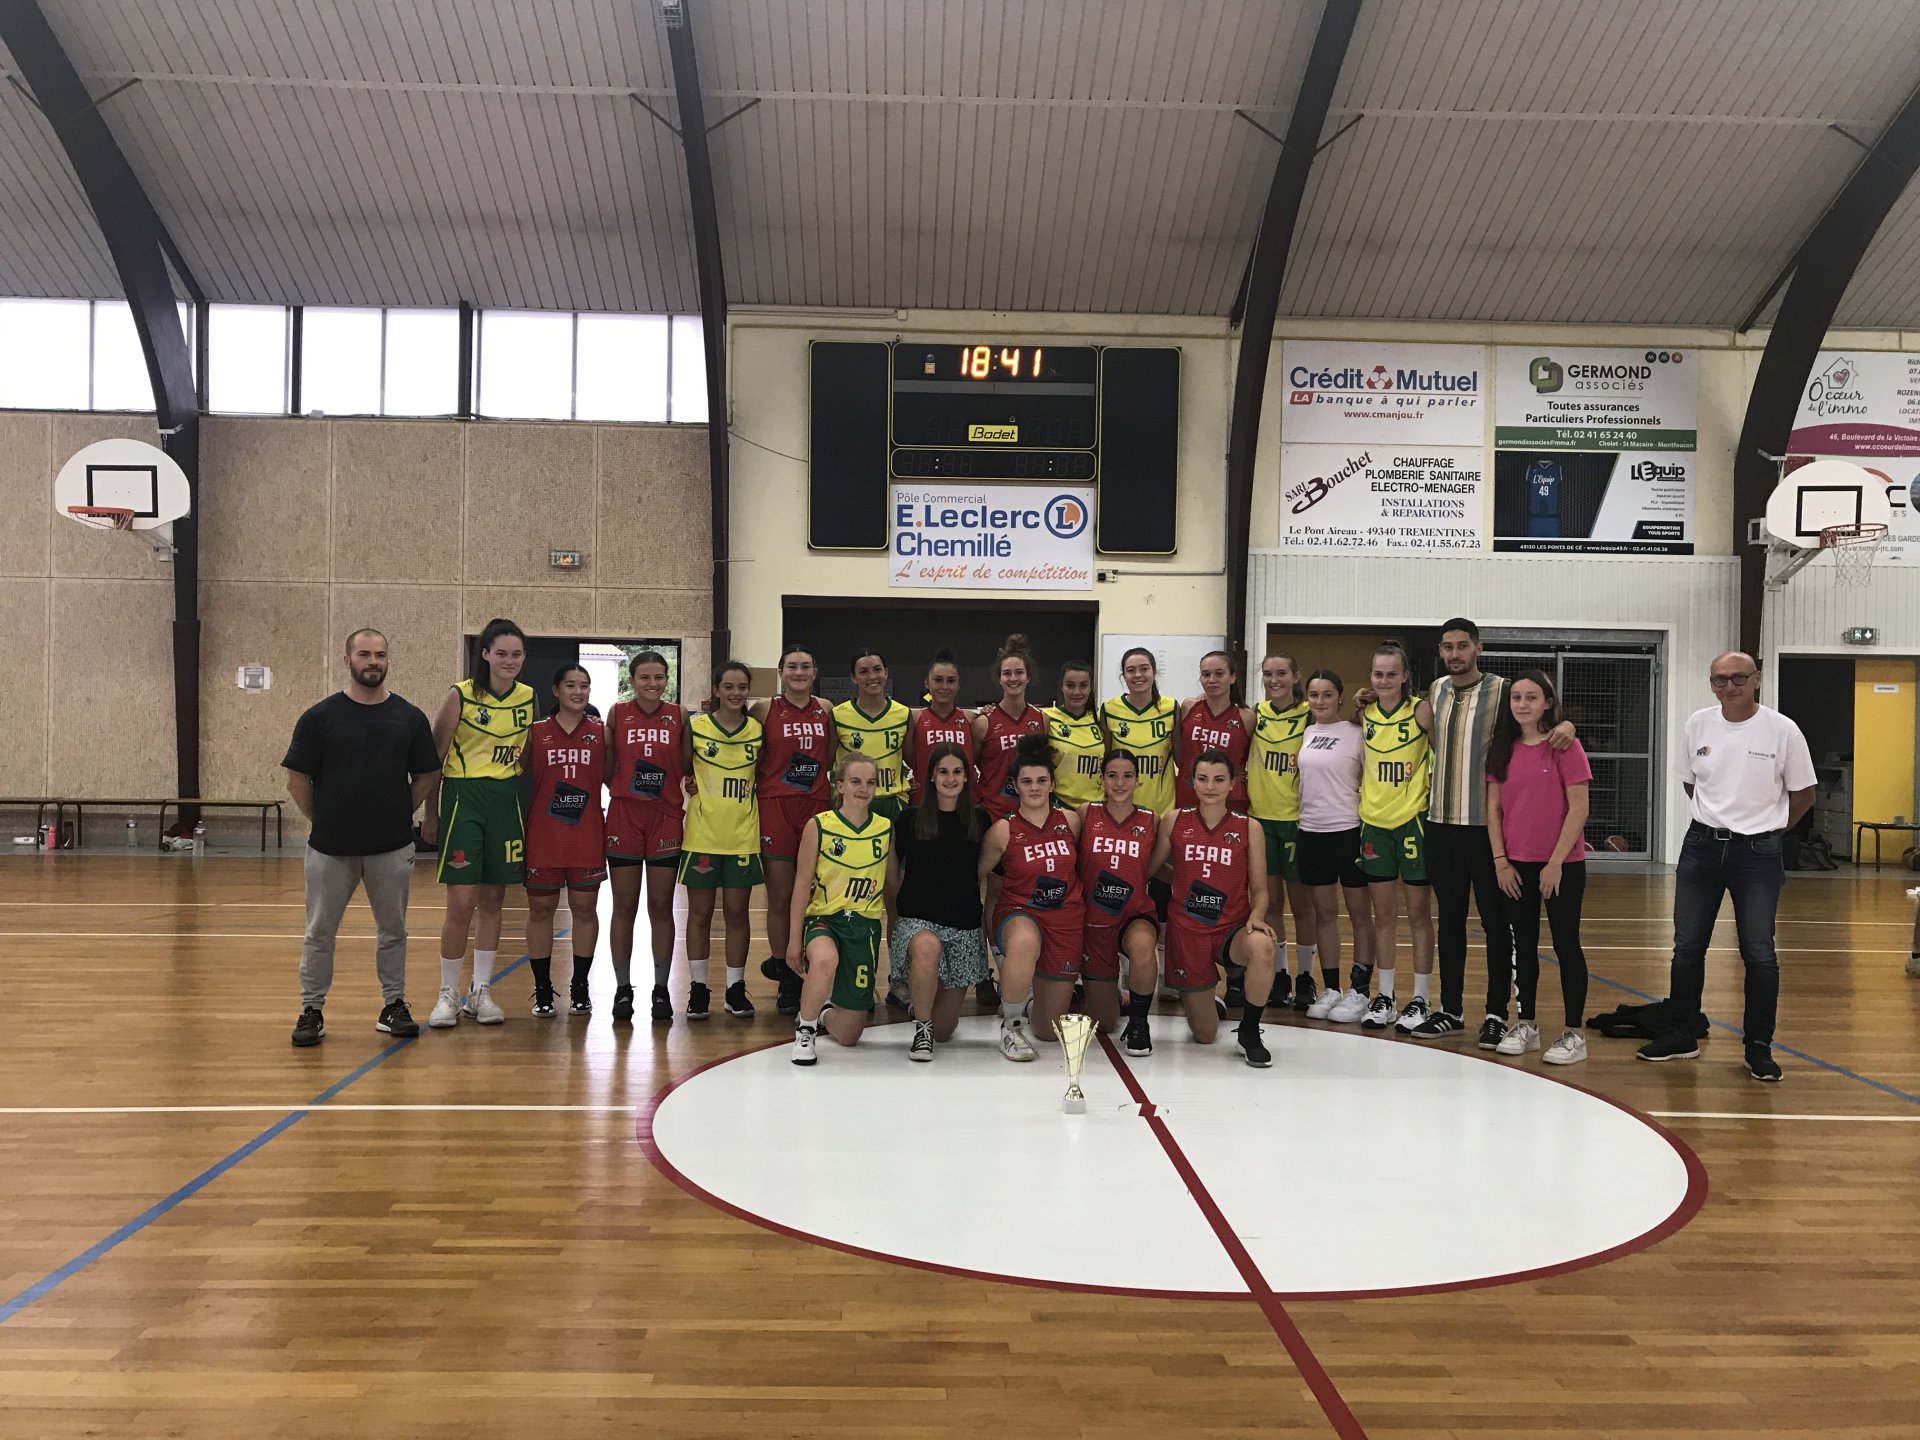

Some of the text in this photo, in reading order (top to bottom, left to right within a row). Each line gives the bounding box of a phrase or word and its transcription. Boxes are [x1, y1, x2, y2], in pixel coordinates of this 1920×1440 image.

[960, 347, 1042, 377] 18:41
[1290, 366, 1477, 391] Crédit Mutuel
[1568, 365, 1651, 379] GERMOND
[1576, 380, 1644, 390] associés
[1809, 376, 1824, 402] Ô
[1294, 394, 1476, 408] LA banque à qui parler
[1548, 401, 1640, 412] Toutes assurances
[1808, 403, 1816, 412] de
[1344, 410, 1424, 420] www.cmanjou.fr
[1526, 414, 1660, 425] Particuliers Professionnels
[971, 427, 1016, 440] Bodet
[1556, 430, 1572, 438] Tél.
[1613, 431, 1624, 439] 24
[1393, 457, 1454, 468] CHAUFFAGE
[1284, 450, 1374, 514] SARL Bouchet
[1365, 470, 1481, 481] PLOMBERIE SANITAIRE
[1371, 482, 1475, 494] ELECTRO-MENAGER
[1539, 486, 1549, 496] 49
[898, 493, 986, 503] Pôle Commercial
[1381, 498, 1465, 508] INSTALLATIONS
[897, 504, 1040, 528] E.Leclerc
[1392, 510, 1464, 518] REPARATIONS
[1289, 526, 1301, 534] Le
[1304, 526, 1324, 535] Pont
[1327, 527, 1357, 535] Aireau
[1367, 527, 1396, 536] 49340
[1399, 528, 1475, 537] TREMENTINES
[896, 532, 1011, 557] Chemillé
[1283, 537, 1480, 548] Tél.: 02.41.62.72.46 Fax.: 02.41.55.67.23
[973, 563, 991, 578] de
[998, 564, 1088, 583] compétition
[512, 709, 527, 728] 12
[783, 723, 824, 738] ESAB
[1150, 721, 1165, 738] 10
[1288, 719, 1298, 735] 7
[1398, 723, 1409, 742] 5
[627, 728, 670, 744] ESAB
[798, 737, 812, 749] 10
[884, 731, 899, 749] 13
[926, 730, 965, 745] ESAB
[1192, 726, 1230, 748] ESAB
[548, 749, 590, 766] ESAB
[644, 744, 652, 756] 6
[744, 744, 754, 761] 9
[563, 765, 576, 778] 11
[1265, 751, 1296, 776] mp3
[1378, 761, 1412, 787] mp3
[505, 840, 523, 863] 12
[872, 839, 882, 858] 6
[1024, 840, 1070, 862] ESAB
[1093, 837, 1139, 858] ESAB
[1185, 844, 1232, 866] ESAB
[1284, 842, 1296, 863] 7
[1404, 837, 1418, 859] 5
[1046, 858, 1055, 872] 8
[1110, 855, 1119, 869] 9
[1203, 863, 1211, 878] 5
[845, 878, 877, 903] mp3
[856, 965, 868, 988] 6
